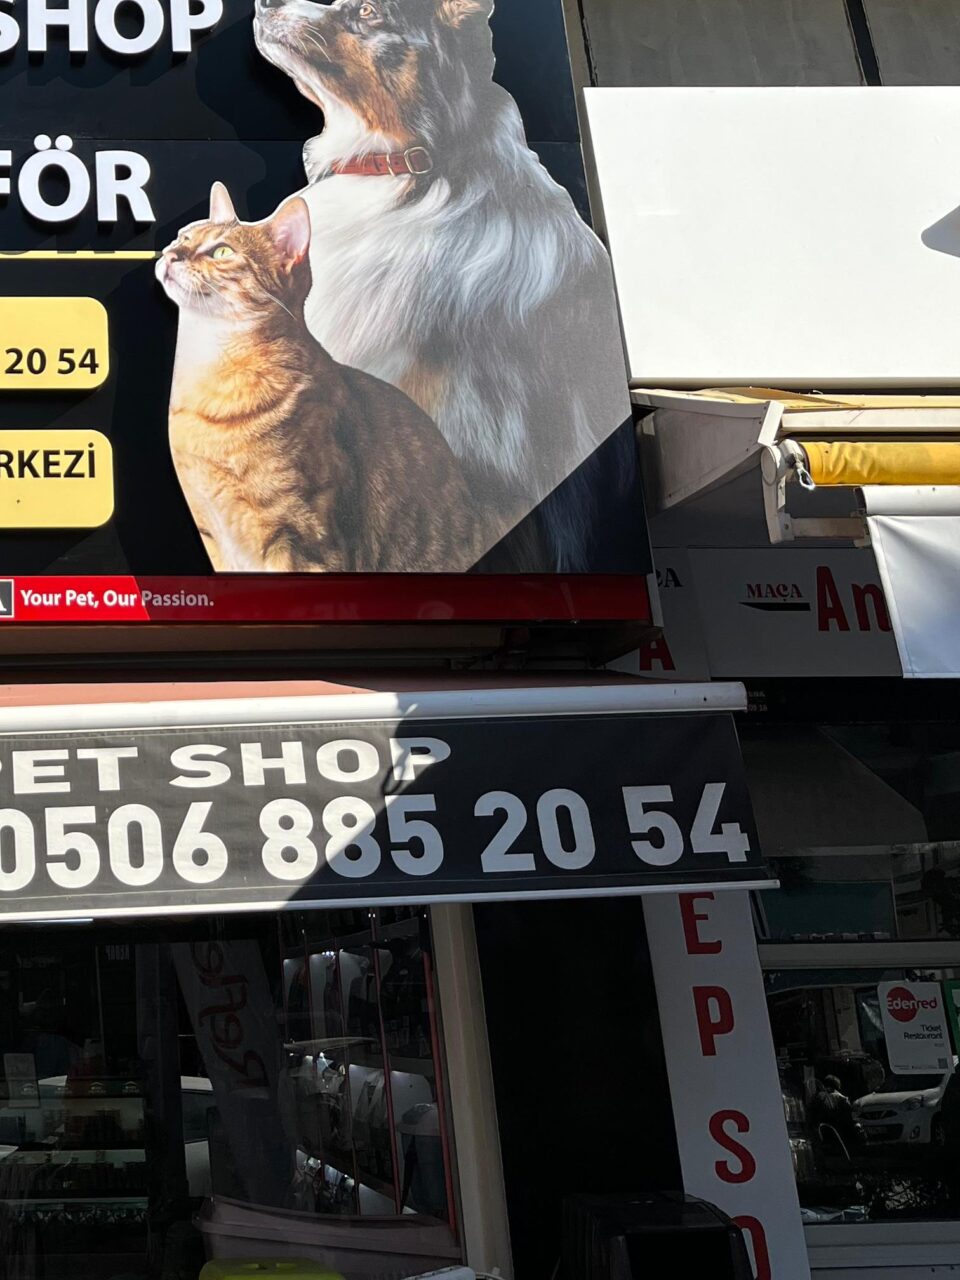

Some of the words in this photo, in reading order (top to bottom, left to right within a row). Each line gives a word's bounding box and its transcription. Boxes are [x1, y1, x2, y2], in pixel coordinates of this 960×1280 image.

[5, 347, 48, 375] 20
[56, 347, 100, 375] 54
[20, 590, 62, 608] Your
[65, 590, 99, 610] Pet,
[103, 590, 137, 607] Our
[141, 590, 215, 607] Passion.
[169, 737, 451, 787] SHOP
[259, 793, 444, 881] 885
[473, 788, 595, 873] 20
[622, 782, 750, 866] 54
[887, 996, 937, 1010] Edenred
